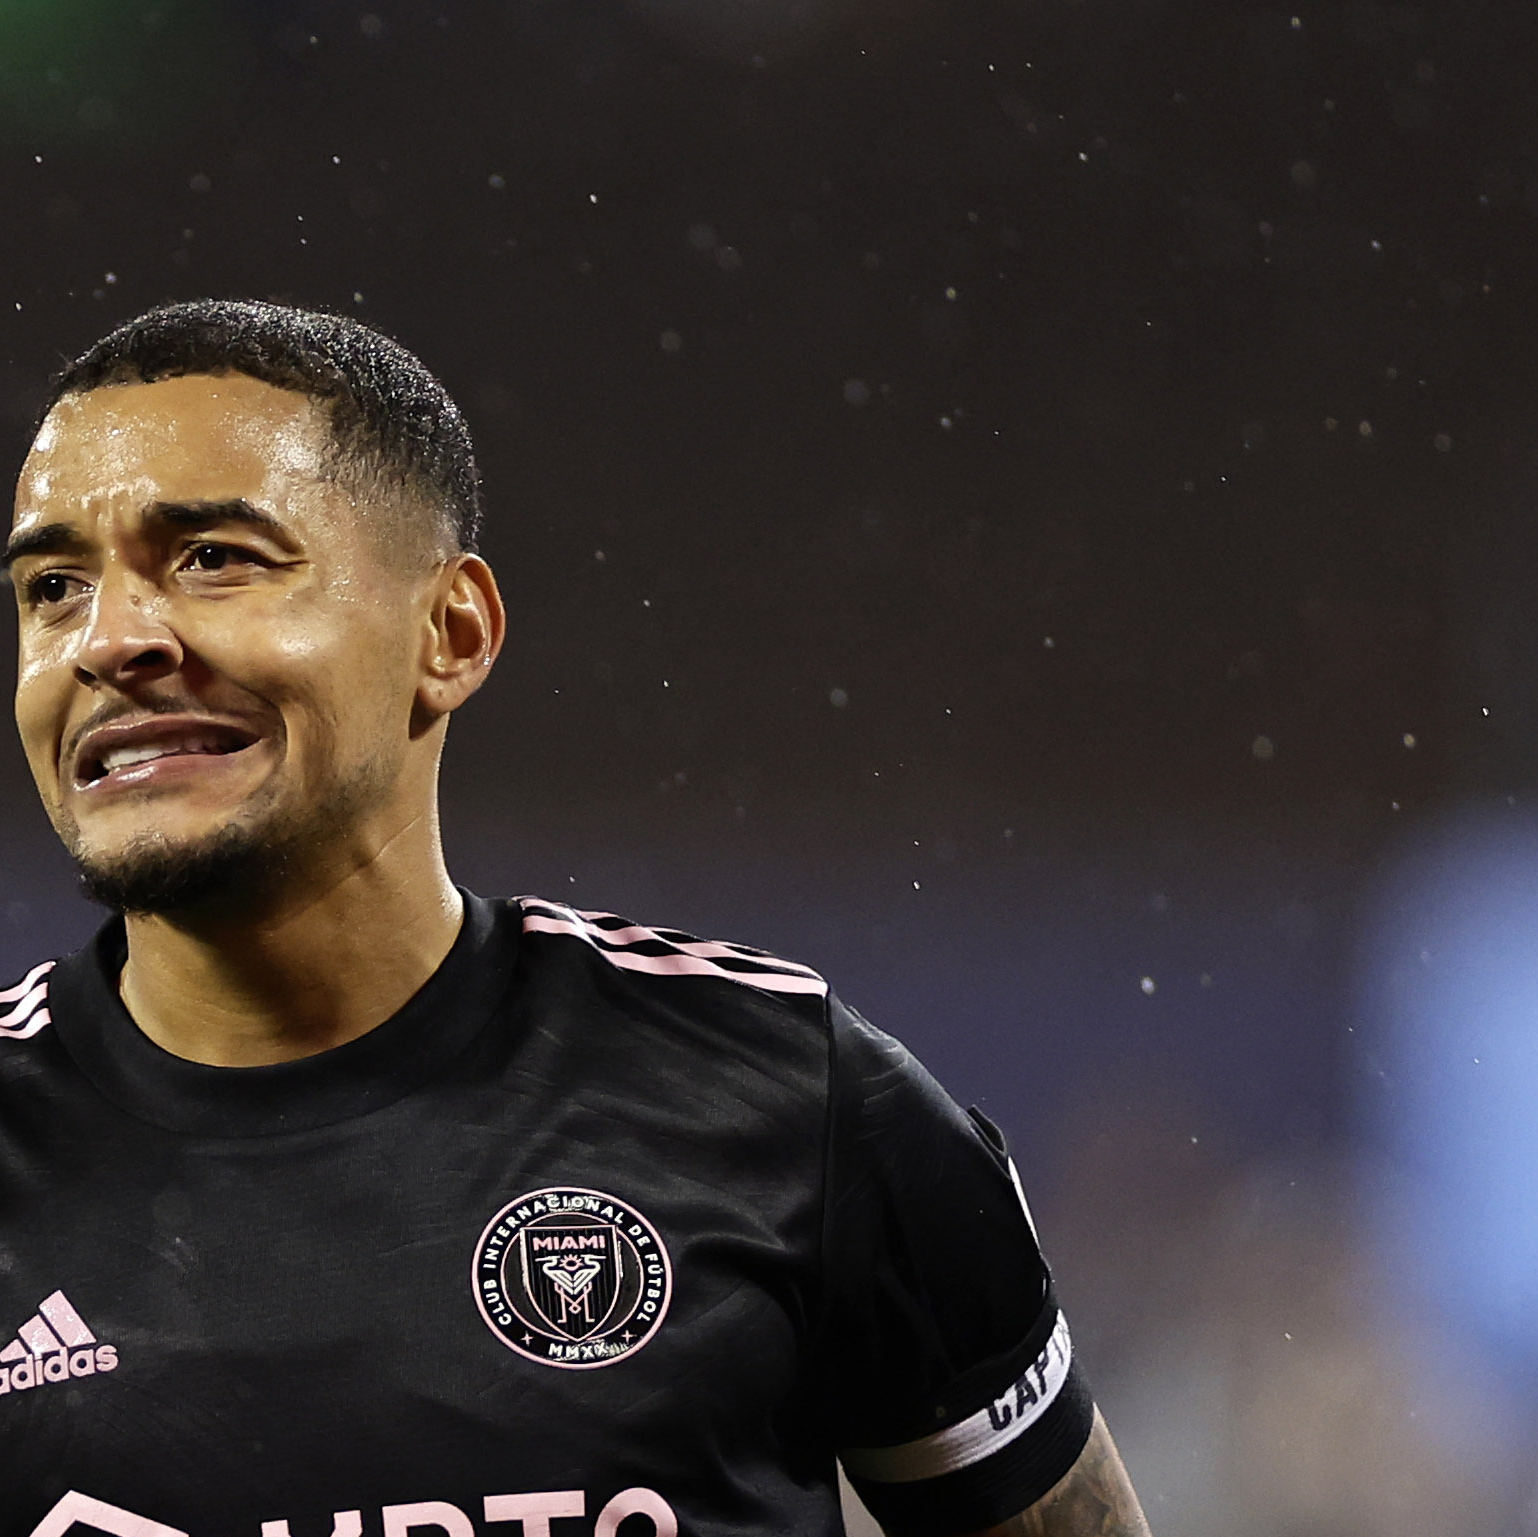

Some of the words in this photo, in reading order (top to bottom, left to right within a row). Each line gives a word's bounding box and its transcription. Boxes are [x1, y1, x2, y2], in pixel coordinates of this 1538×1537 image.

[483, 1194, 625, 1269] INTERNACIONAL
[532, 1235, 606, 1251] MIAMI
[628, 1224, 651, 1248] DE
[482, 1278, 512, 1326] CLUB
